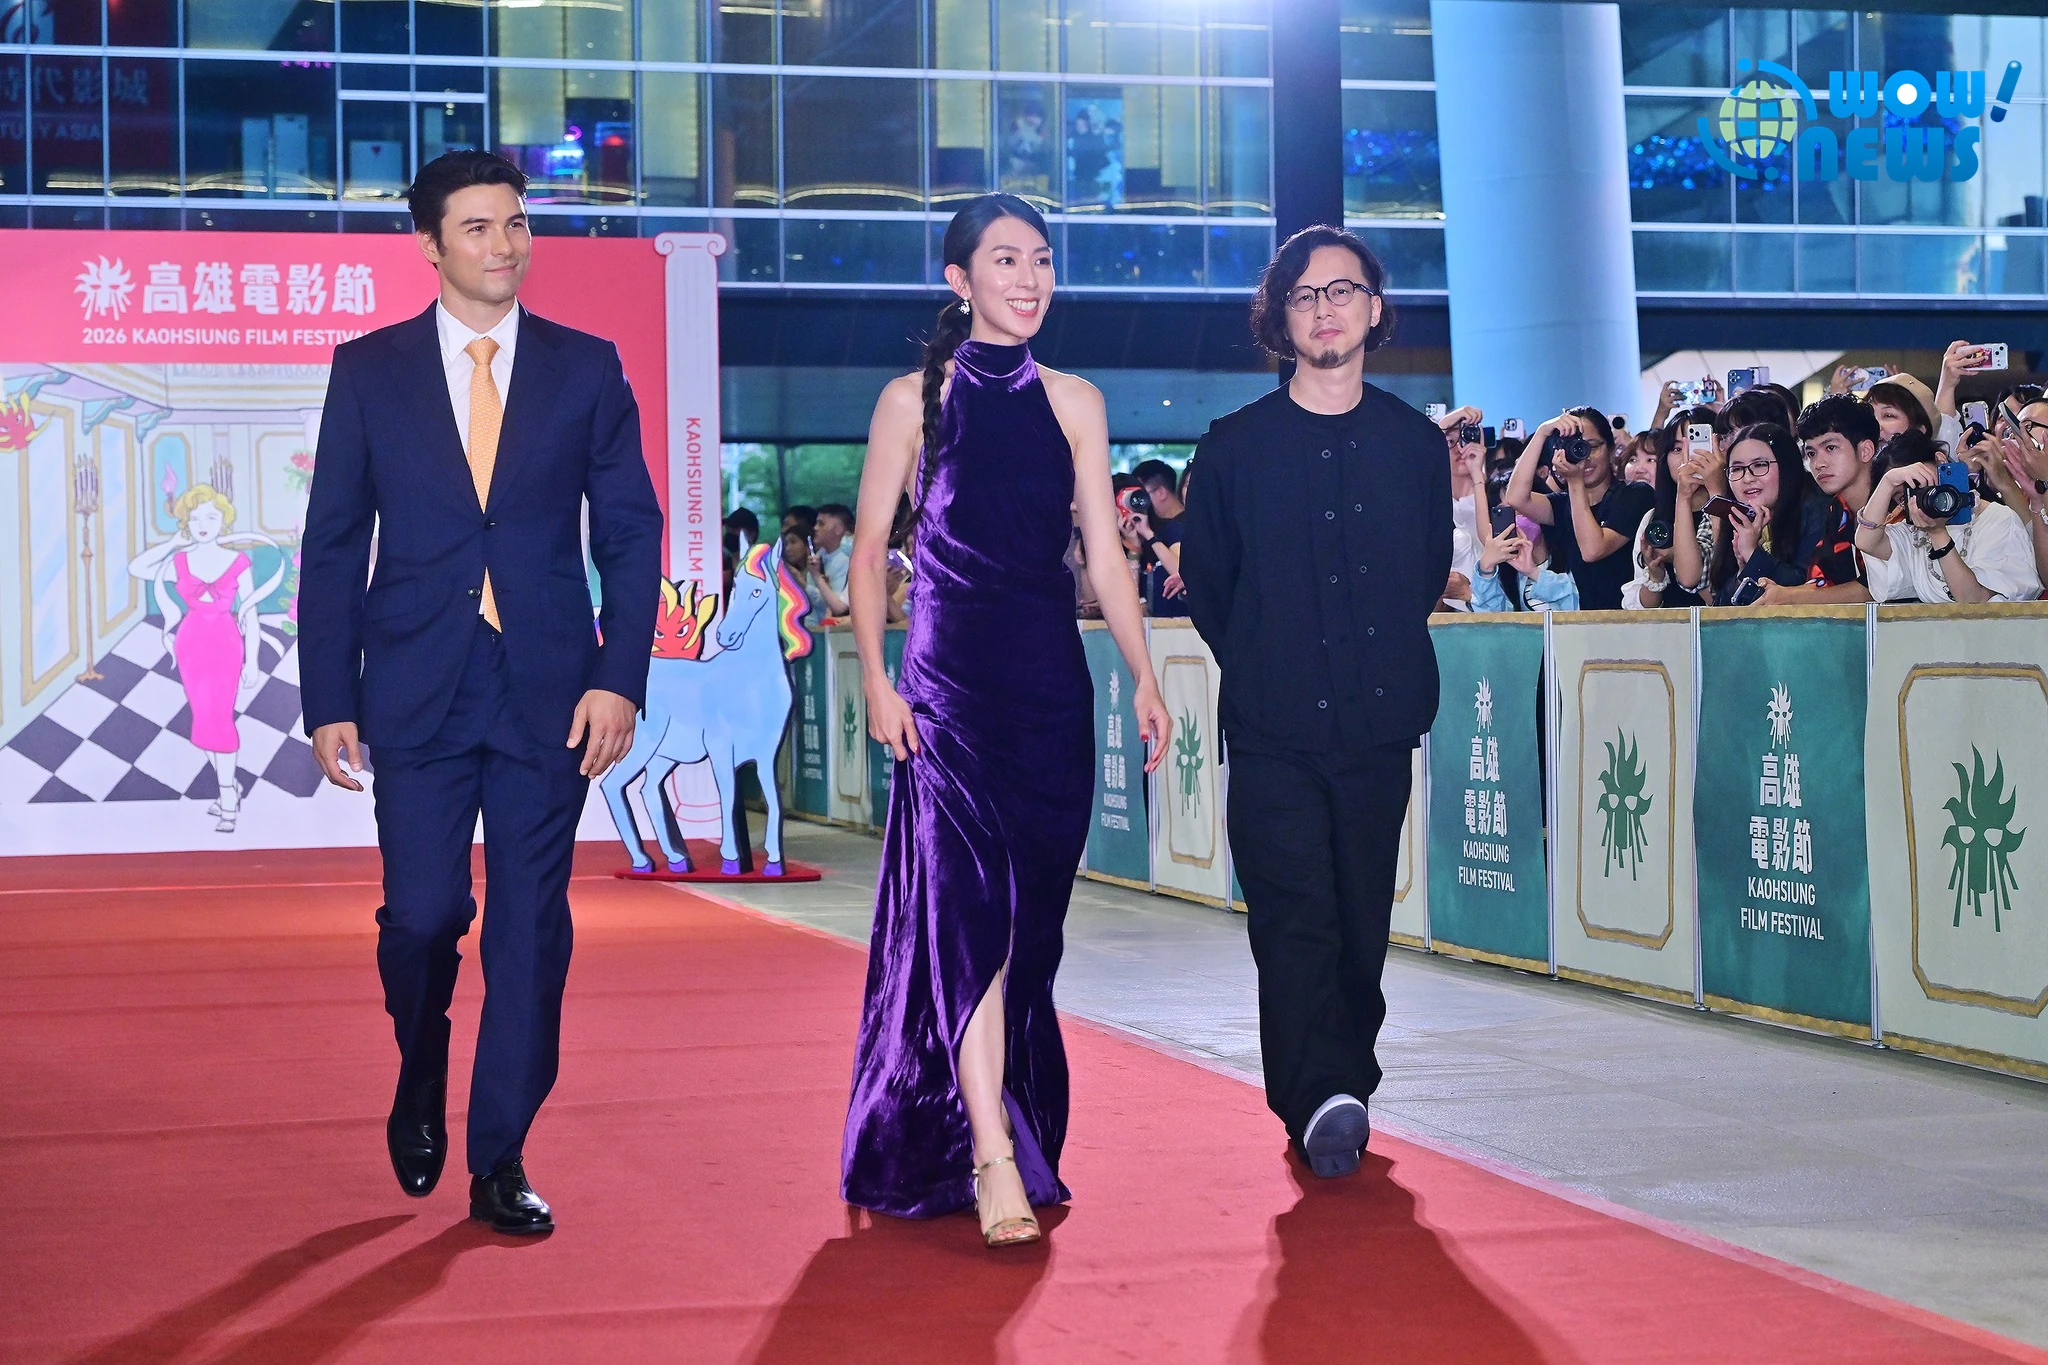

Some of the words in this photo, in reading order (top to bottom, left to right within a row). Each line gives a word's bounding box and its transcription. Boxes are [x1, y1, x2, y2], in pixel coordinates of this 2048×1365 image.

[142, 260, 377, 316] 高雄電影節
[82, 327, 127, 345] 2026
[132, 328, 241, 346] KAOHSIUNG
[245, 328, 288, 346] FILM
[292, 328, 369, 346] FESTIVA
[686, 417, 704, 524] KAOHSIUNG
[687, 530, 704, 572] FILM
[1470, 736, 1500, 782] 高雄
[1760, 752, 1803, 809] 高雄
[1464, 789, 1507, 837] 電影節
[1463, 840, 1510, 863] KAOHSIUNG
[1750, 816, 1813, 874] 電影節
[1458, 866, 1477, 886] FILM
[1478, 869, 1515, 892] FESTIVAL
[1748, 876, 1815, 905] KAOHSIUNG
[1741, 907, 1767, 932] FILM
[1771, 911, 1824, 940] FESTIVAL
